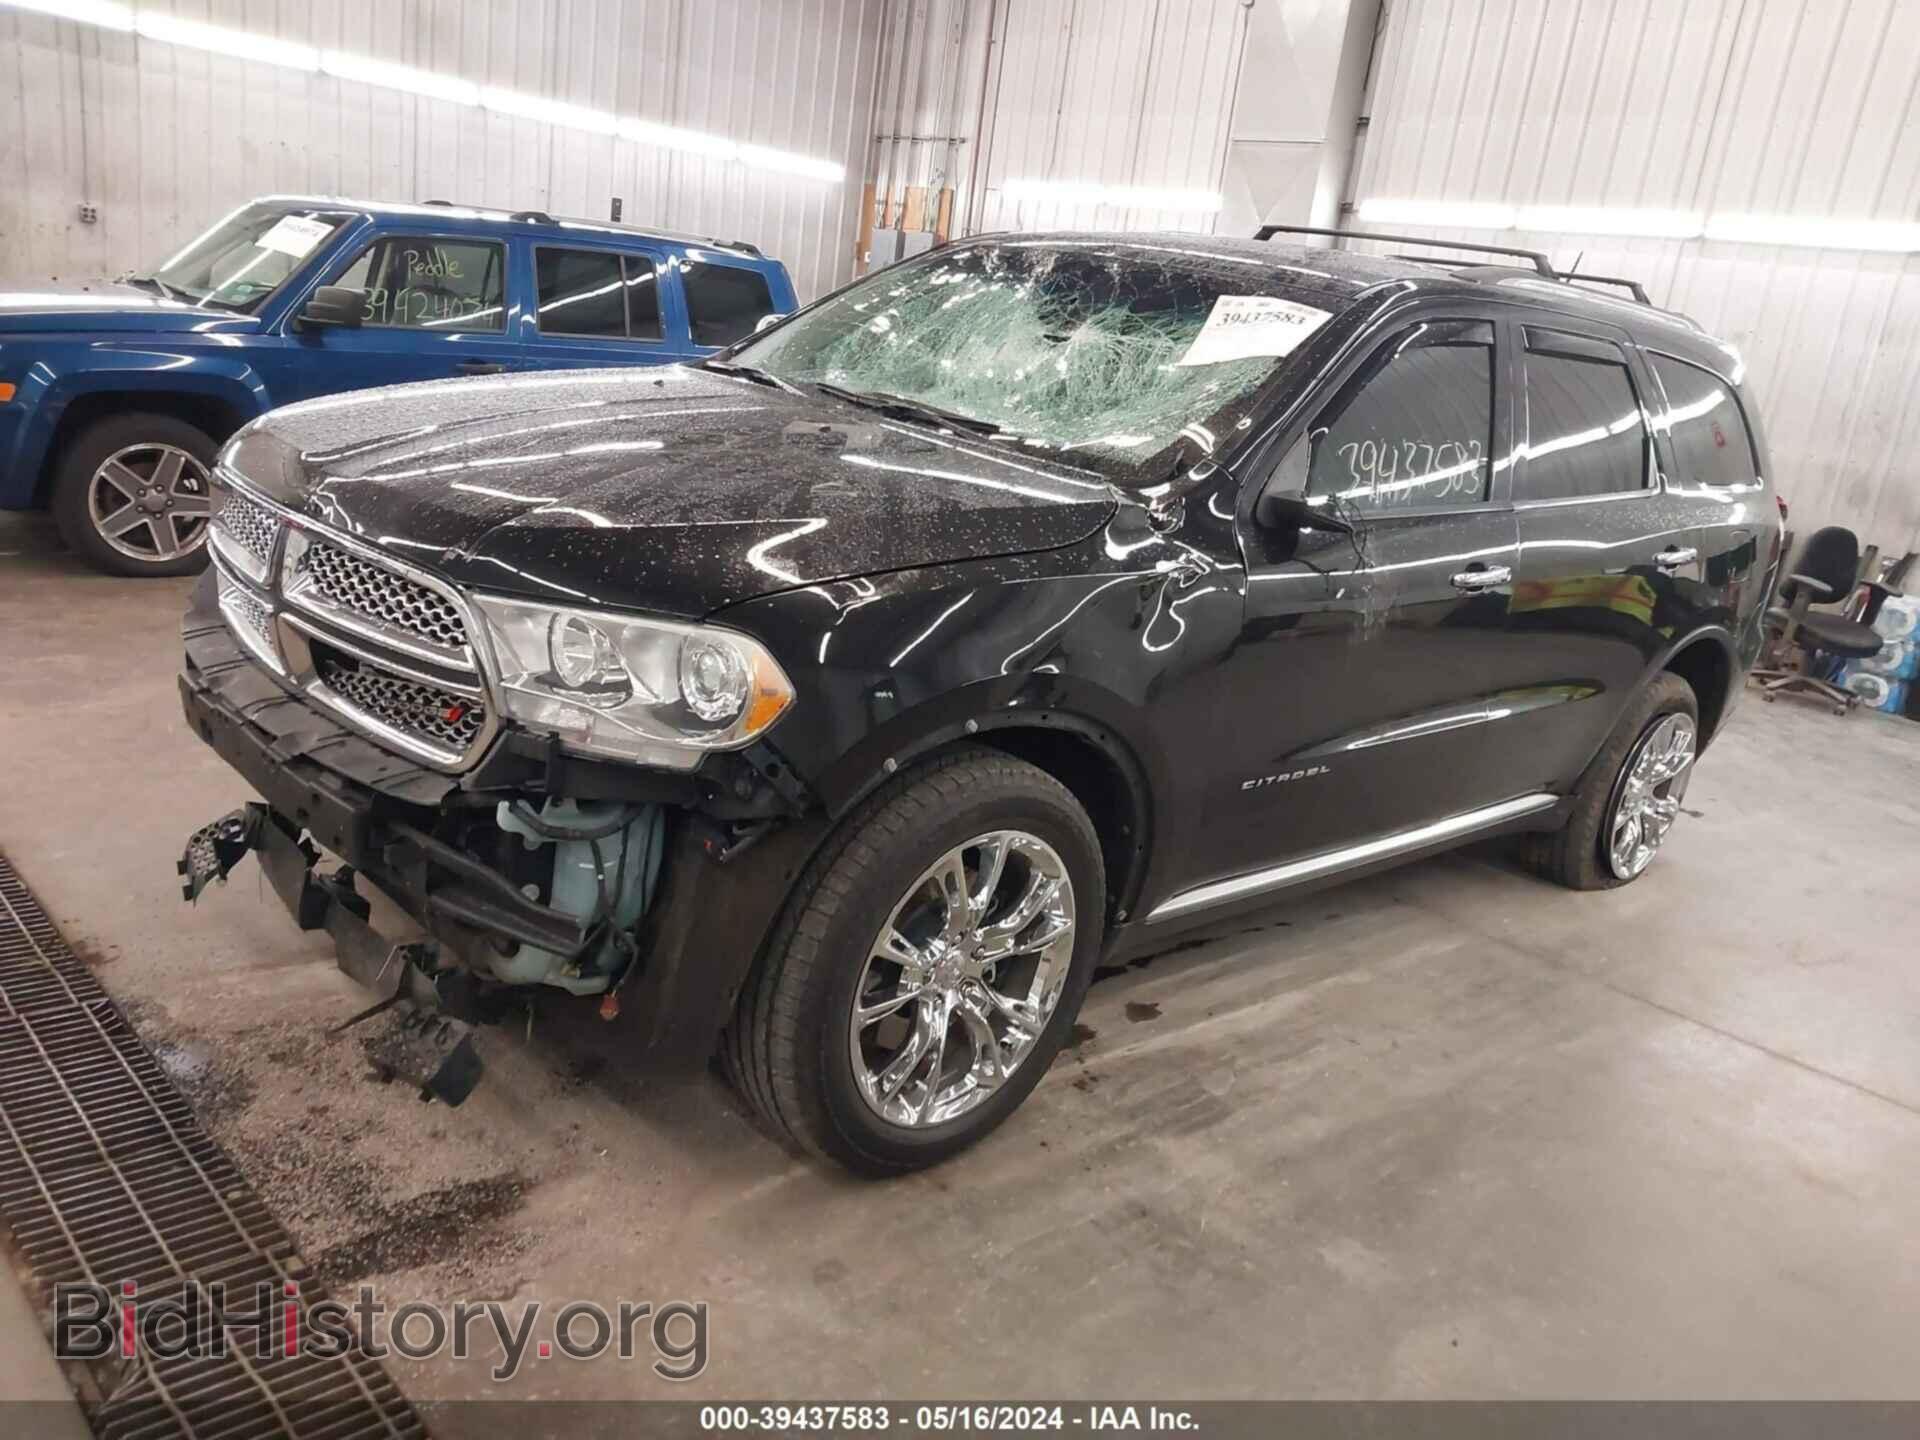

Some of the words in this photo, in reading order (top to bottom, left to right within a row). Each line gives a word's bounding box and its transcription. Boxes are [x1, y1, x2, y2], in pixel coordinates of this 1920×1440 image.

[403, 247, 464, 280] Peddle
[1216, 311, 1307, 329] 39437583
[1338, 439, 1483, 501] 39437583
[1241, 765, 1331, 790] CITADEL
